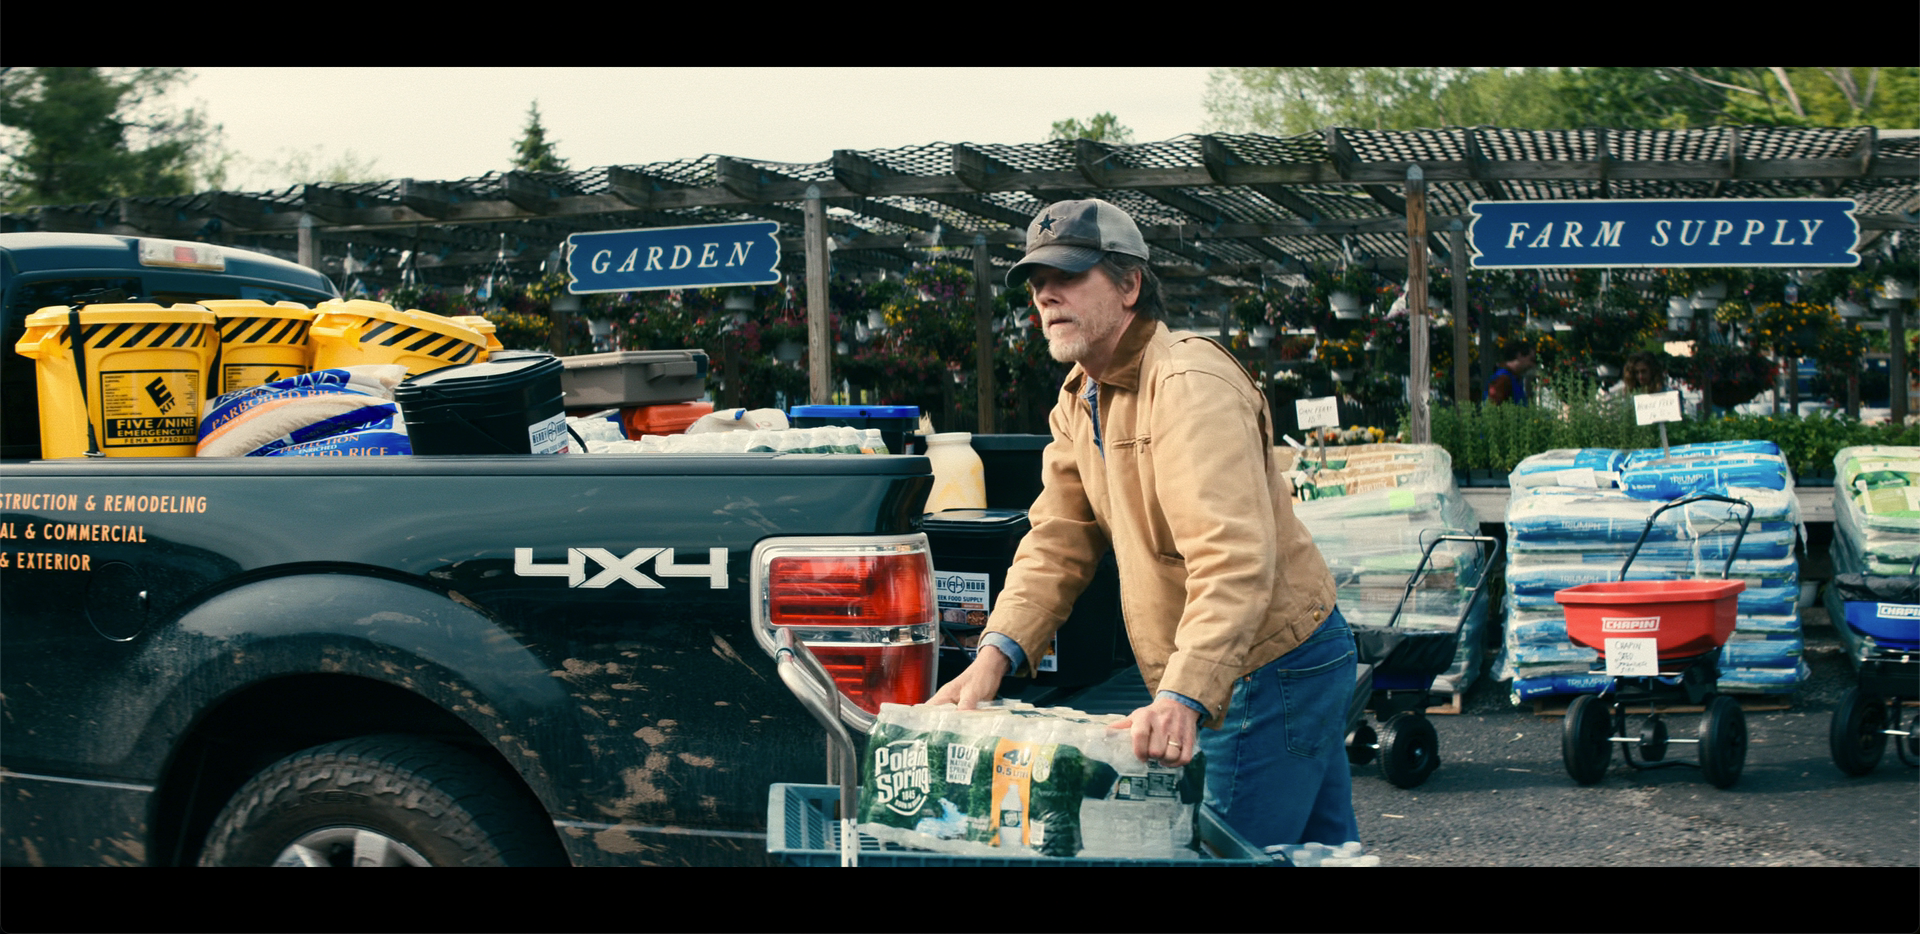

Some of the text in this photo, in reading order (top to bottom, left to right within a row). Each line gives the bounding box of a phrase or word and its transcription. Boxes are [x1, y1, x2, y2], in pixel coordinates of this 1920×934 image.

[1504, 219, 1824, 249] FARM SUPPLY
[591, 241, 754, 274] GARDEN
[159, 396, 176, 415] KIT
[117, 418, 154, 430] FIVE
[117, 427, 194, 437] EMERGENCY KIT
[152, 436, 191, 444] APPROVED
[298, 444, 338, 454] ENRICHED
[349, 446, 389, 457] RICE
[1669, 473, 1708, 485] TRIUMPH
[84, 495, 96, 511] &
[104, 495, 207, 513] REMODELING
[1561, 520, 1601, 531] TRIUMPH
[24, 523, 36, 540] &
[43, 523, 147, 543] COMMERCIAL
[0, 552, 91, 571] & EXTERIOR
[514, 547, 729, 589] 4X4
[965, 581, 985, 590] HOUR
[1606, 620, 1655, 629] CHAPIN
[1615, 640, 1642, 651] CHAPIN
[996, 765, 1012, 776] 0.5
[876, 767, 931, 804] Spring
